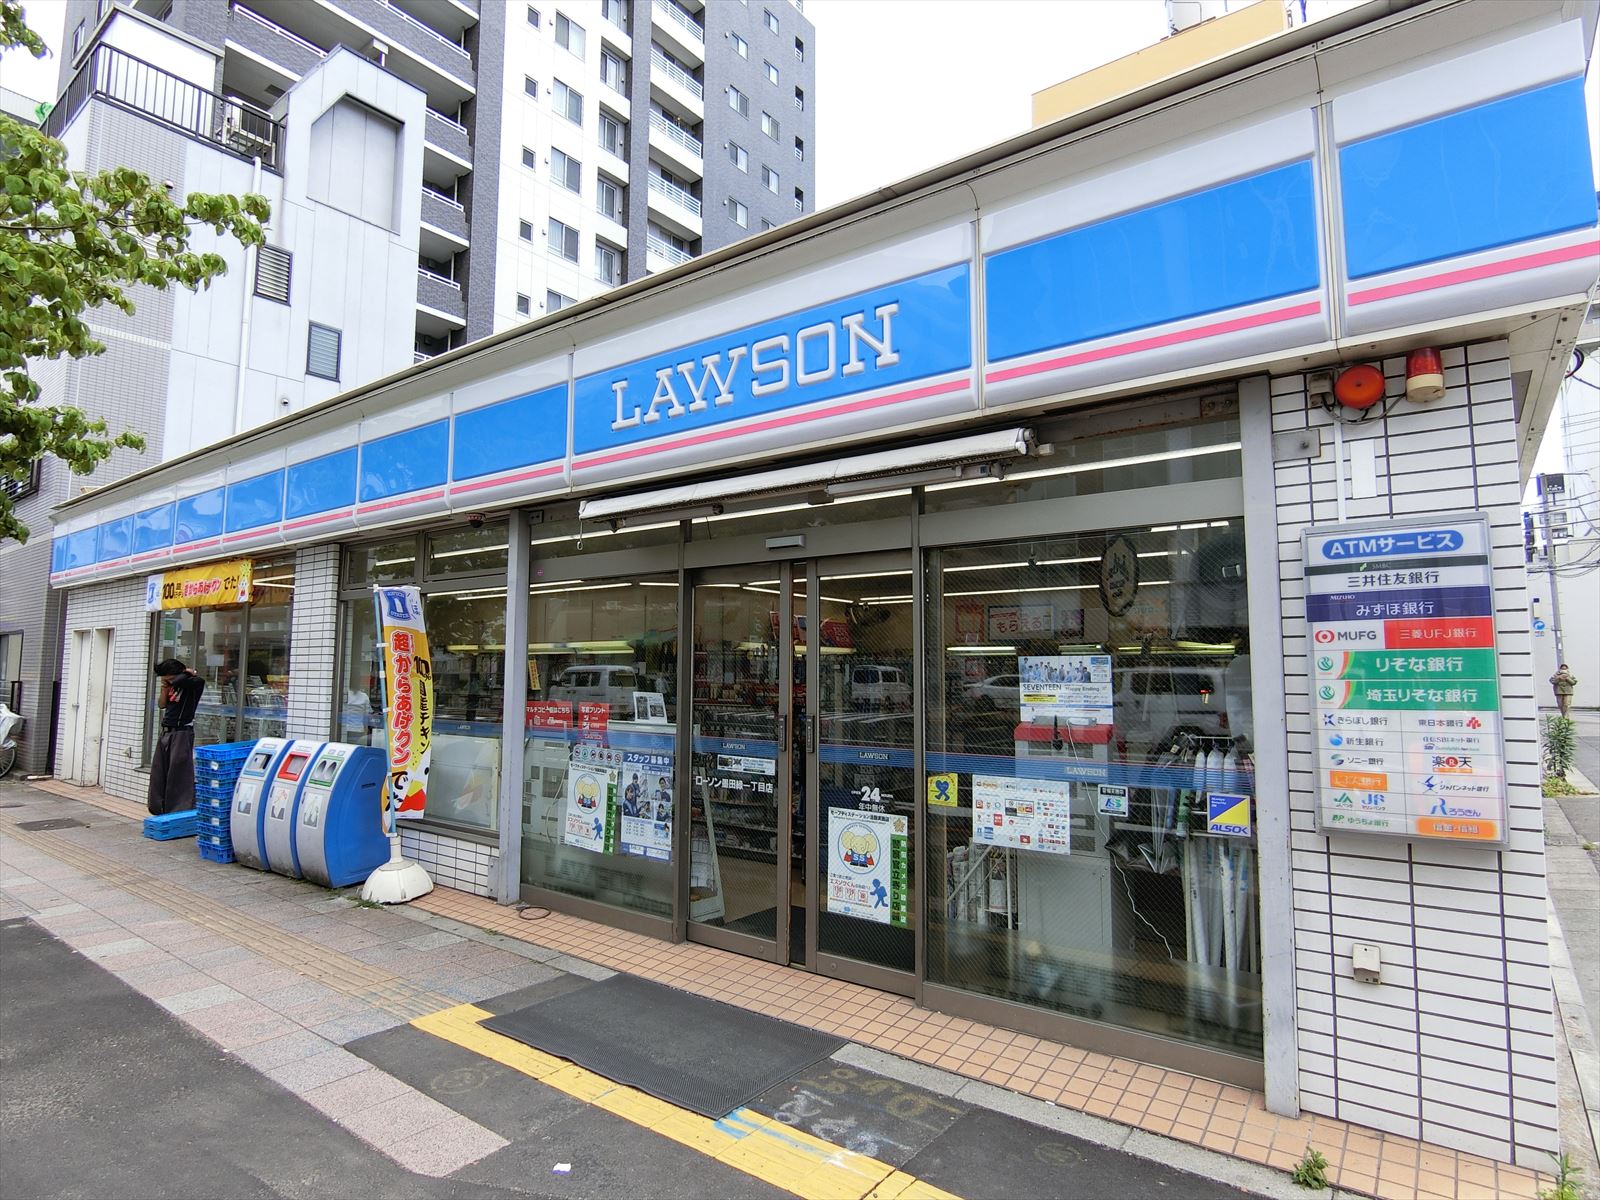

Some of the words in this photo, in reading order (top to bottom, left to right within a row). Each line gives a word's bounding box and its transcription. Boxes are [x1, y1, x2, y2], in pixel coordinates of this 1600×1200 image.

[611, 302, 899, 431] LAWSON
[1330, 531, 1455, 556] ATMサービス
[1347, 570, 1440, 588] 三井住友銀行
[1356, 601, 1434, 616] みずほ銀行
[1337, 630, 1377, 641] MUFG
[1399, 627, 1478, 640] 三菱UFJ銀行
[1376, 656, 1463, 673] りそな銀行
[1022, 683, 1062, 691] SEVENTEEN
[1366, 688, 1478, 704] 埼玉りそな銀行
[1337, 715, 1388, 726] きらぼし銀行
[1418, 719, 1463, 728] 東日本銀行
[1346, 737, 1384, 746] 新生銀行
[859, 751, 889, 760] LAWSON
[1347, 757, 1384, 766] ソニー銀行
[695, 775, 774, 794] ローソン墨田緑一丁目店
[1440, 784, 1489, 792] ジャパンネット銀行
[861, 786, 881, 802] 24
[859, 802, 886, 812] 年中無休
[1449, 808, 1481, 817] ろうきん
[1210, 823, 1248, 835] ALSOK
